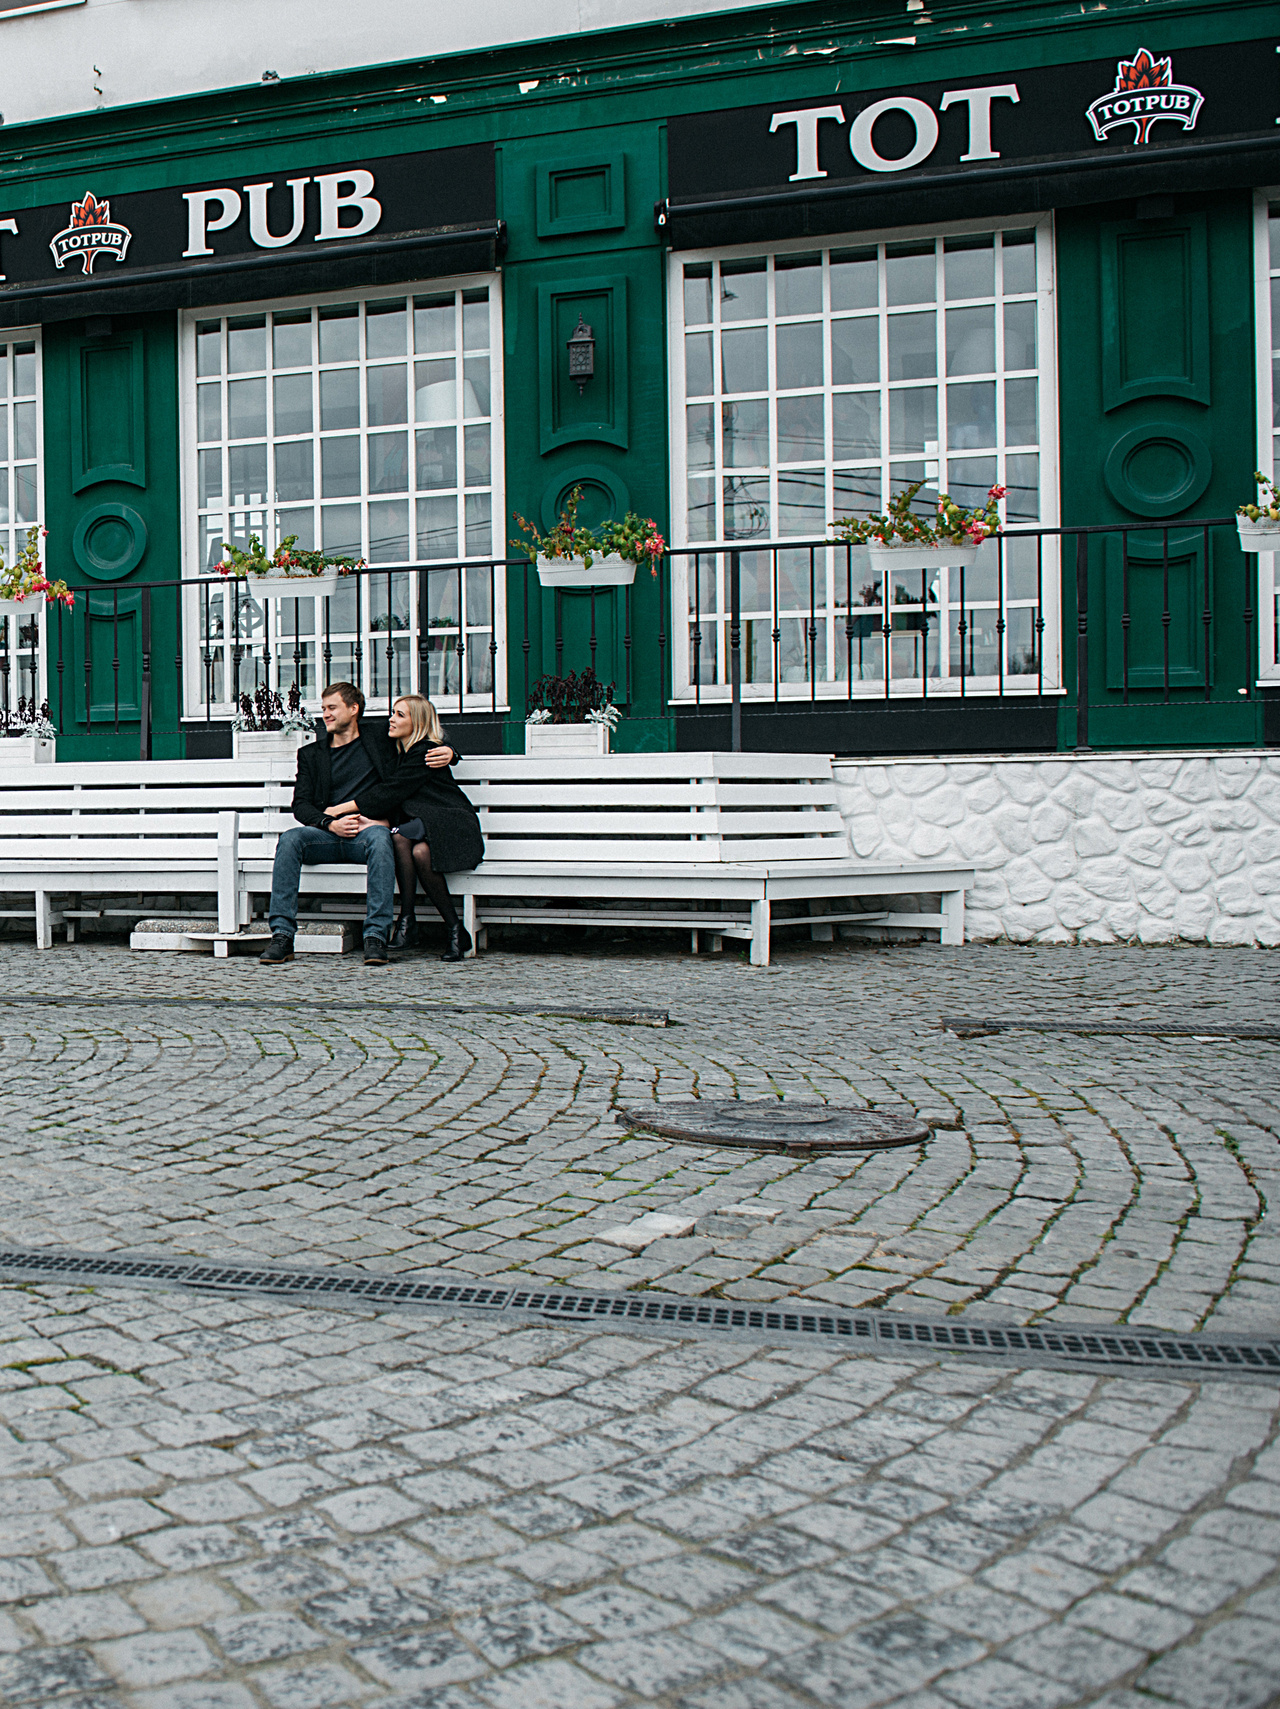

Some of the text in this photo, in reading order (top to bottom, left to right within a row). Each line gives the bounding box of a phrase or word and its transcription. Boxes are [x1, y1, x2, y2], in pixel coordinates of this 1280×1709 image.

[768, 83, 1020, 182] TOT
[1098, 94, 1191, 120] TOTPUB
[58, 232, 123, 252] TOTPUB
[182, 169, 382, 258] PUB
